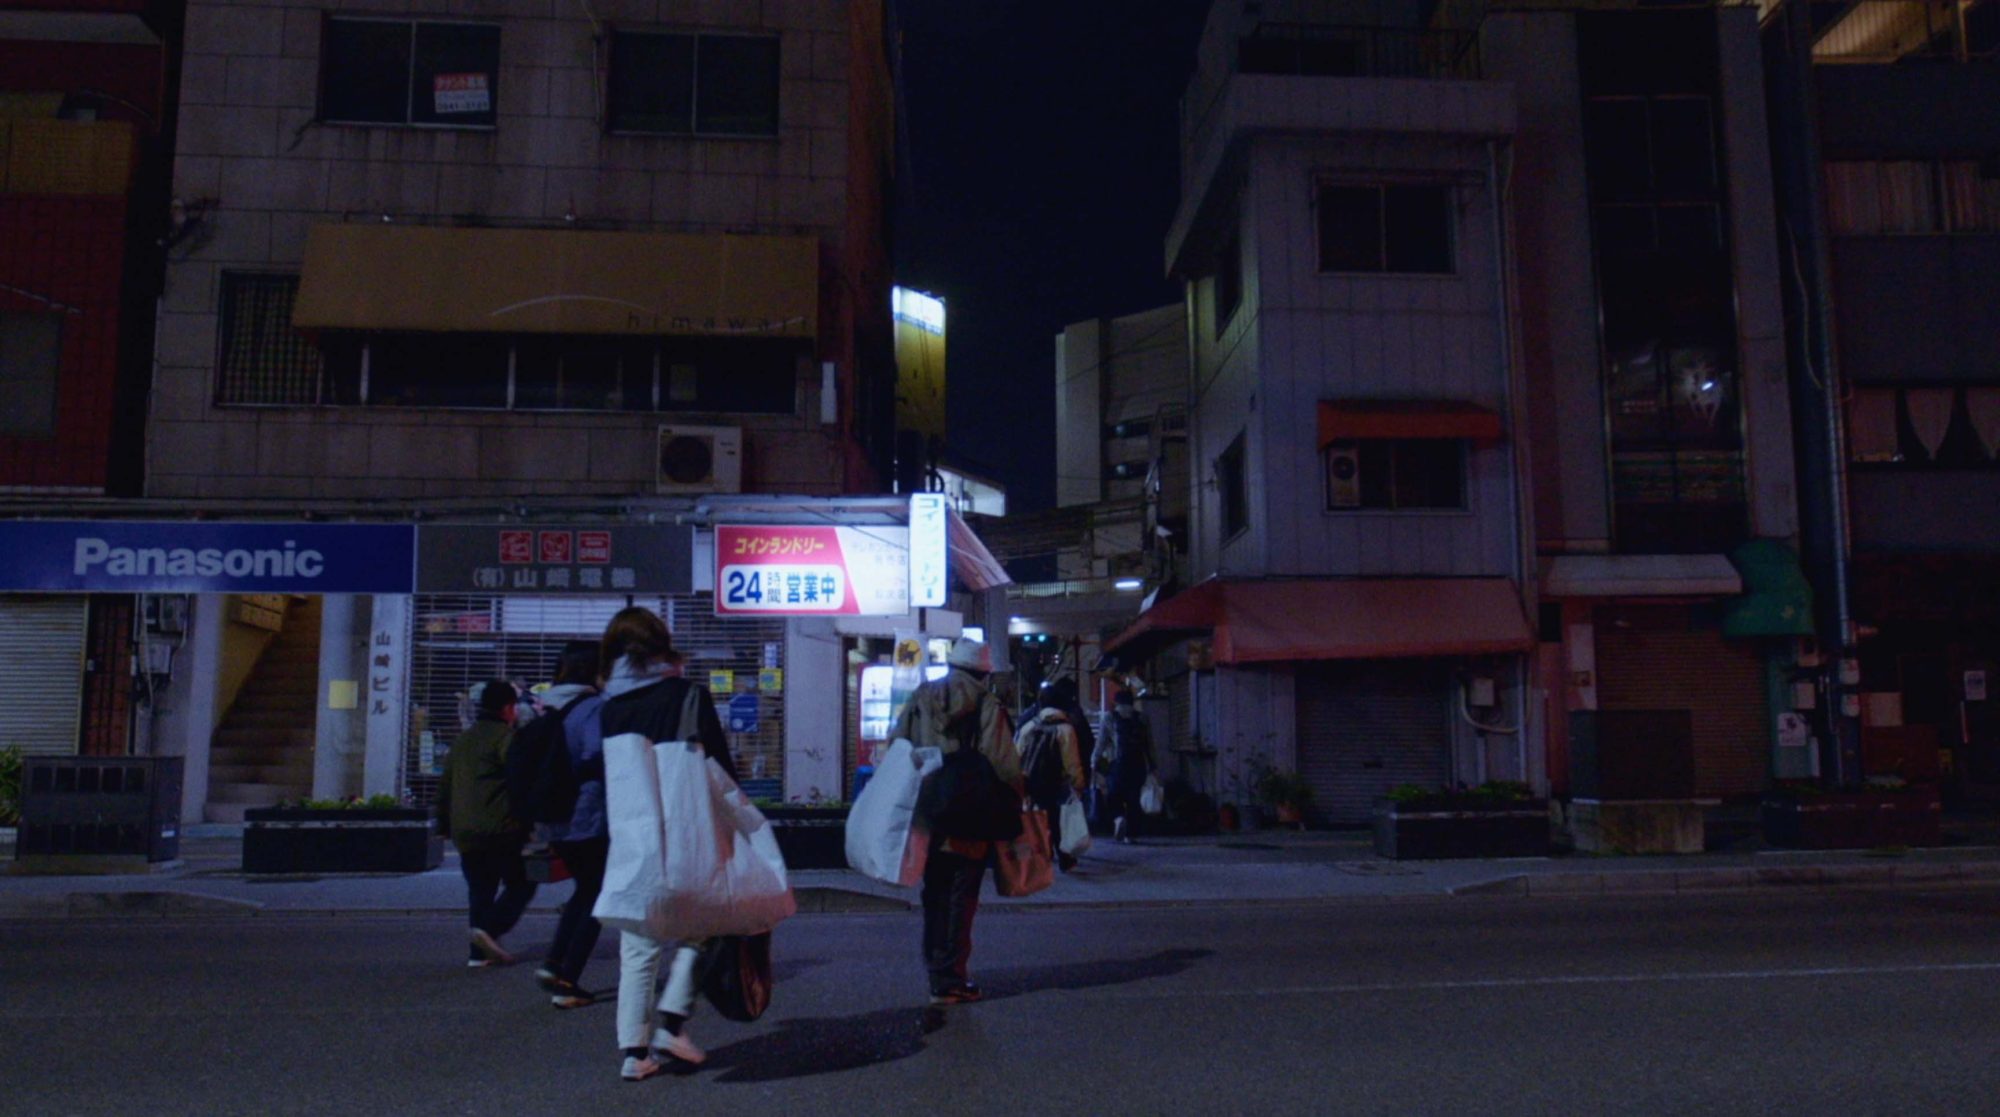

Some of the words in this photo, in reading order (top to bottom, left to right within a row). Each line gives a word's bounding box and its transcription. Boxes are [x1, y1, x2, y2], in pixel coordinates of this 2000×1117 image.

[628, 311, 806, 328] himawari
[735, 537, 825, 555] コインランドリー
[73, 538, 323, 577] Panasonic
